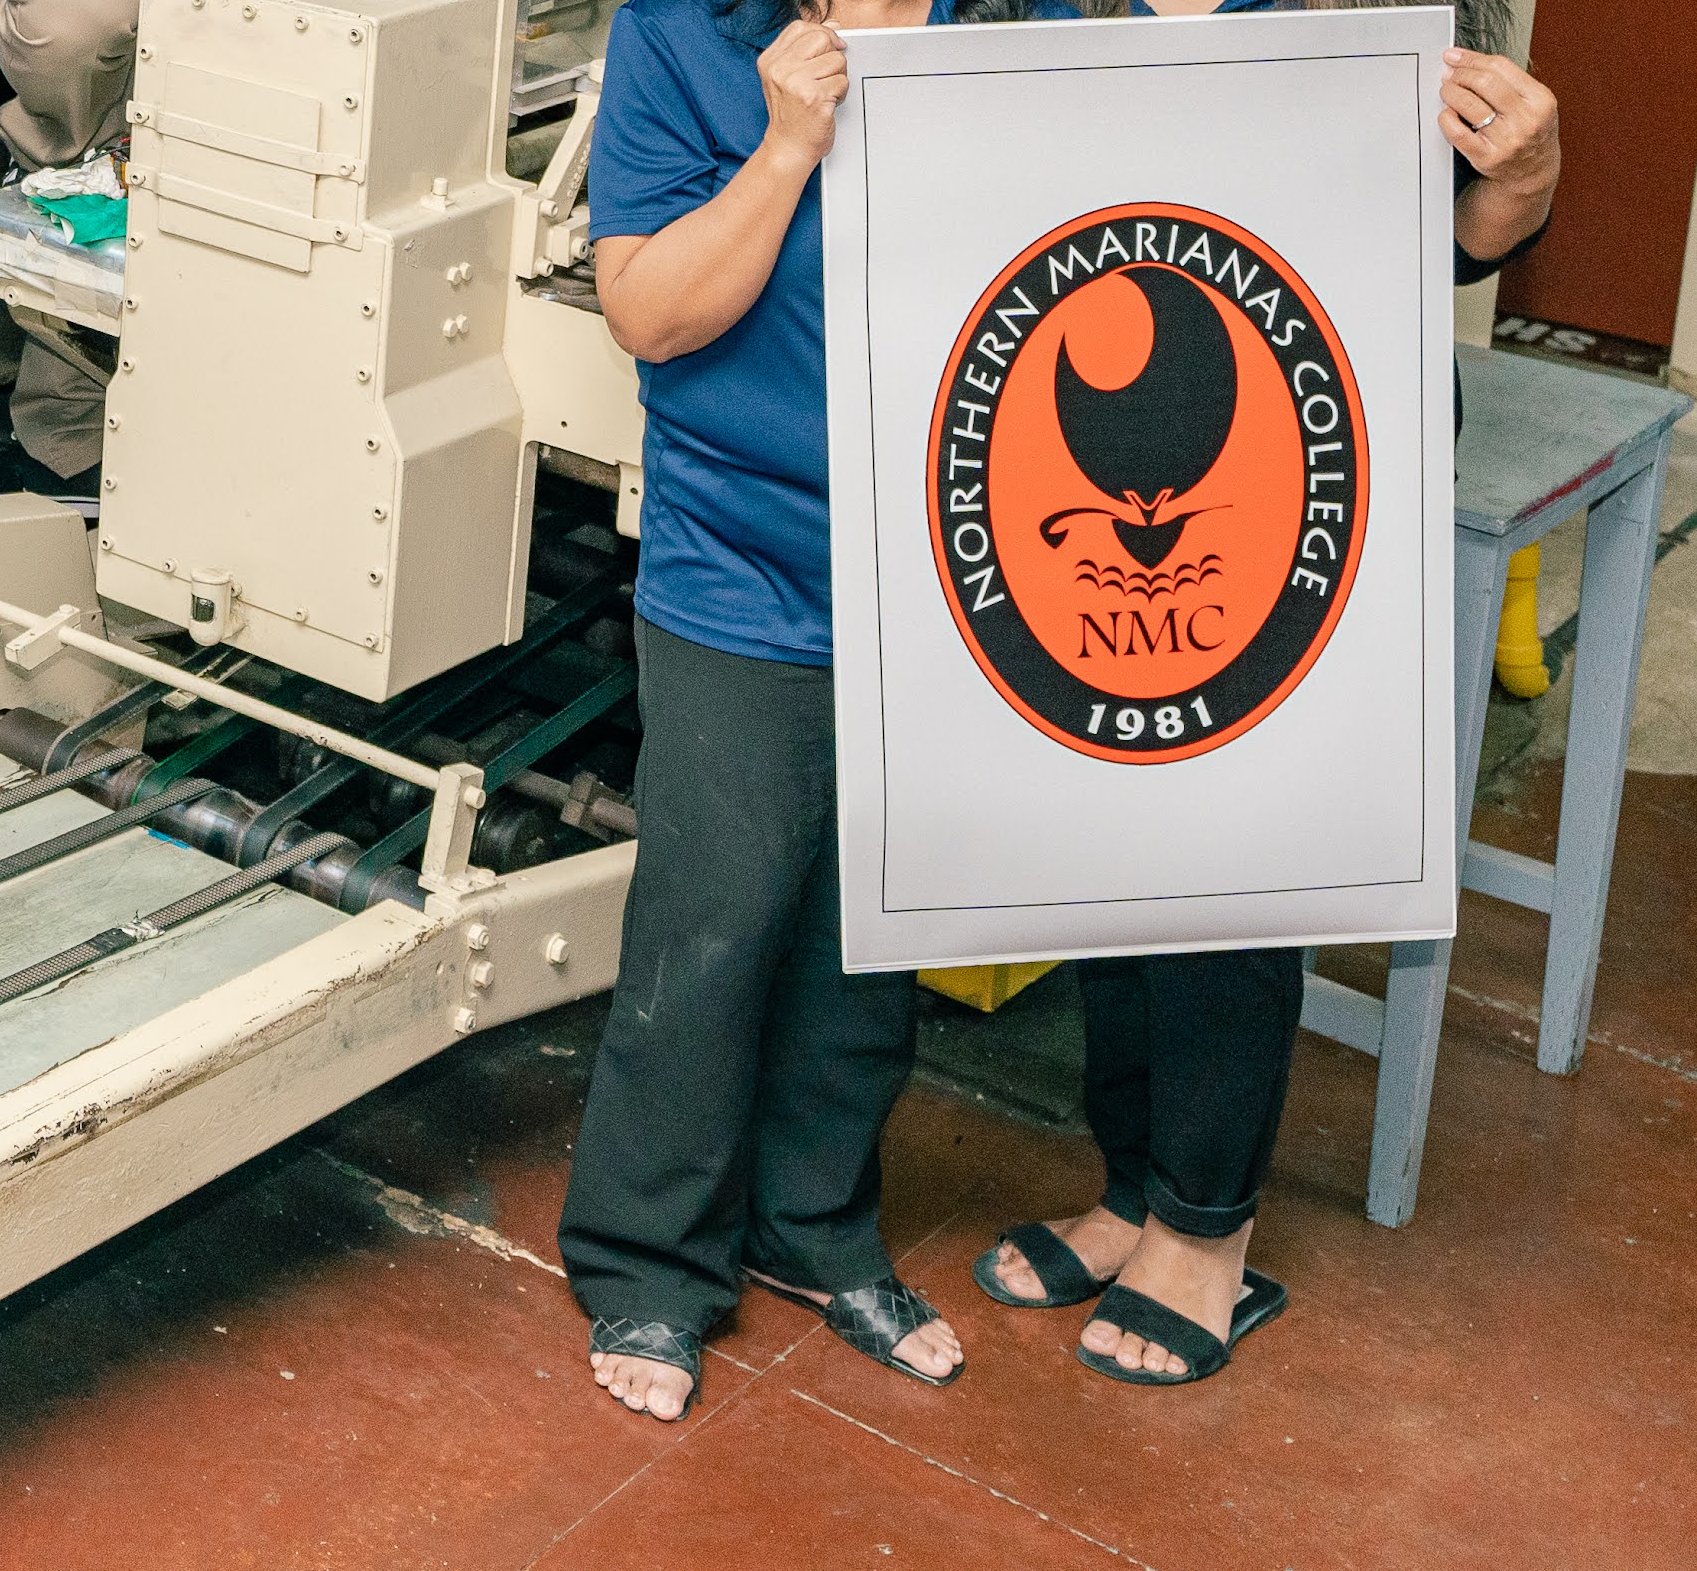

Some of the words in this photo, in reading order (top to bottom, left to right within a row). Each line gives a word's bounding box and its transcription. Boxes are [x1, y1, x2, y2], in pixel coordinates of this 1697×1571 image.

[948, 286, 1040, 613] NORTHERN
[1048, 222, 1306, 347] MARIANAS
[1291, 360, 1346, 598] COLLEGE
[1077, 604, 1226, 659] NMC
[1086, 695, 1213, 741] 1981
